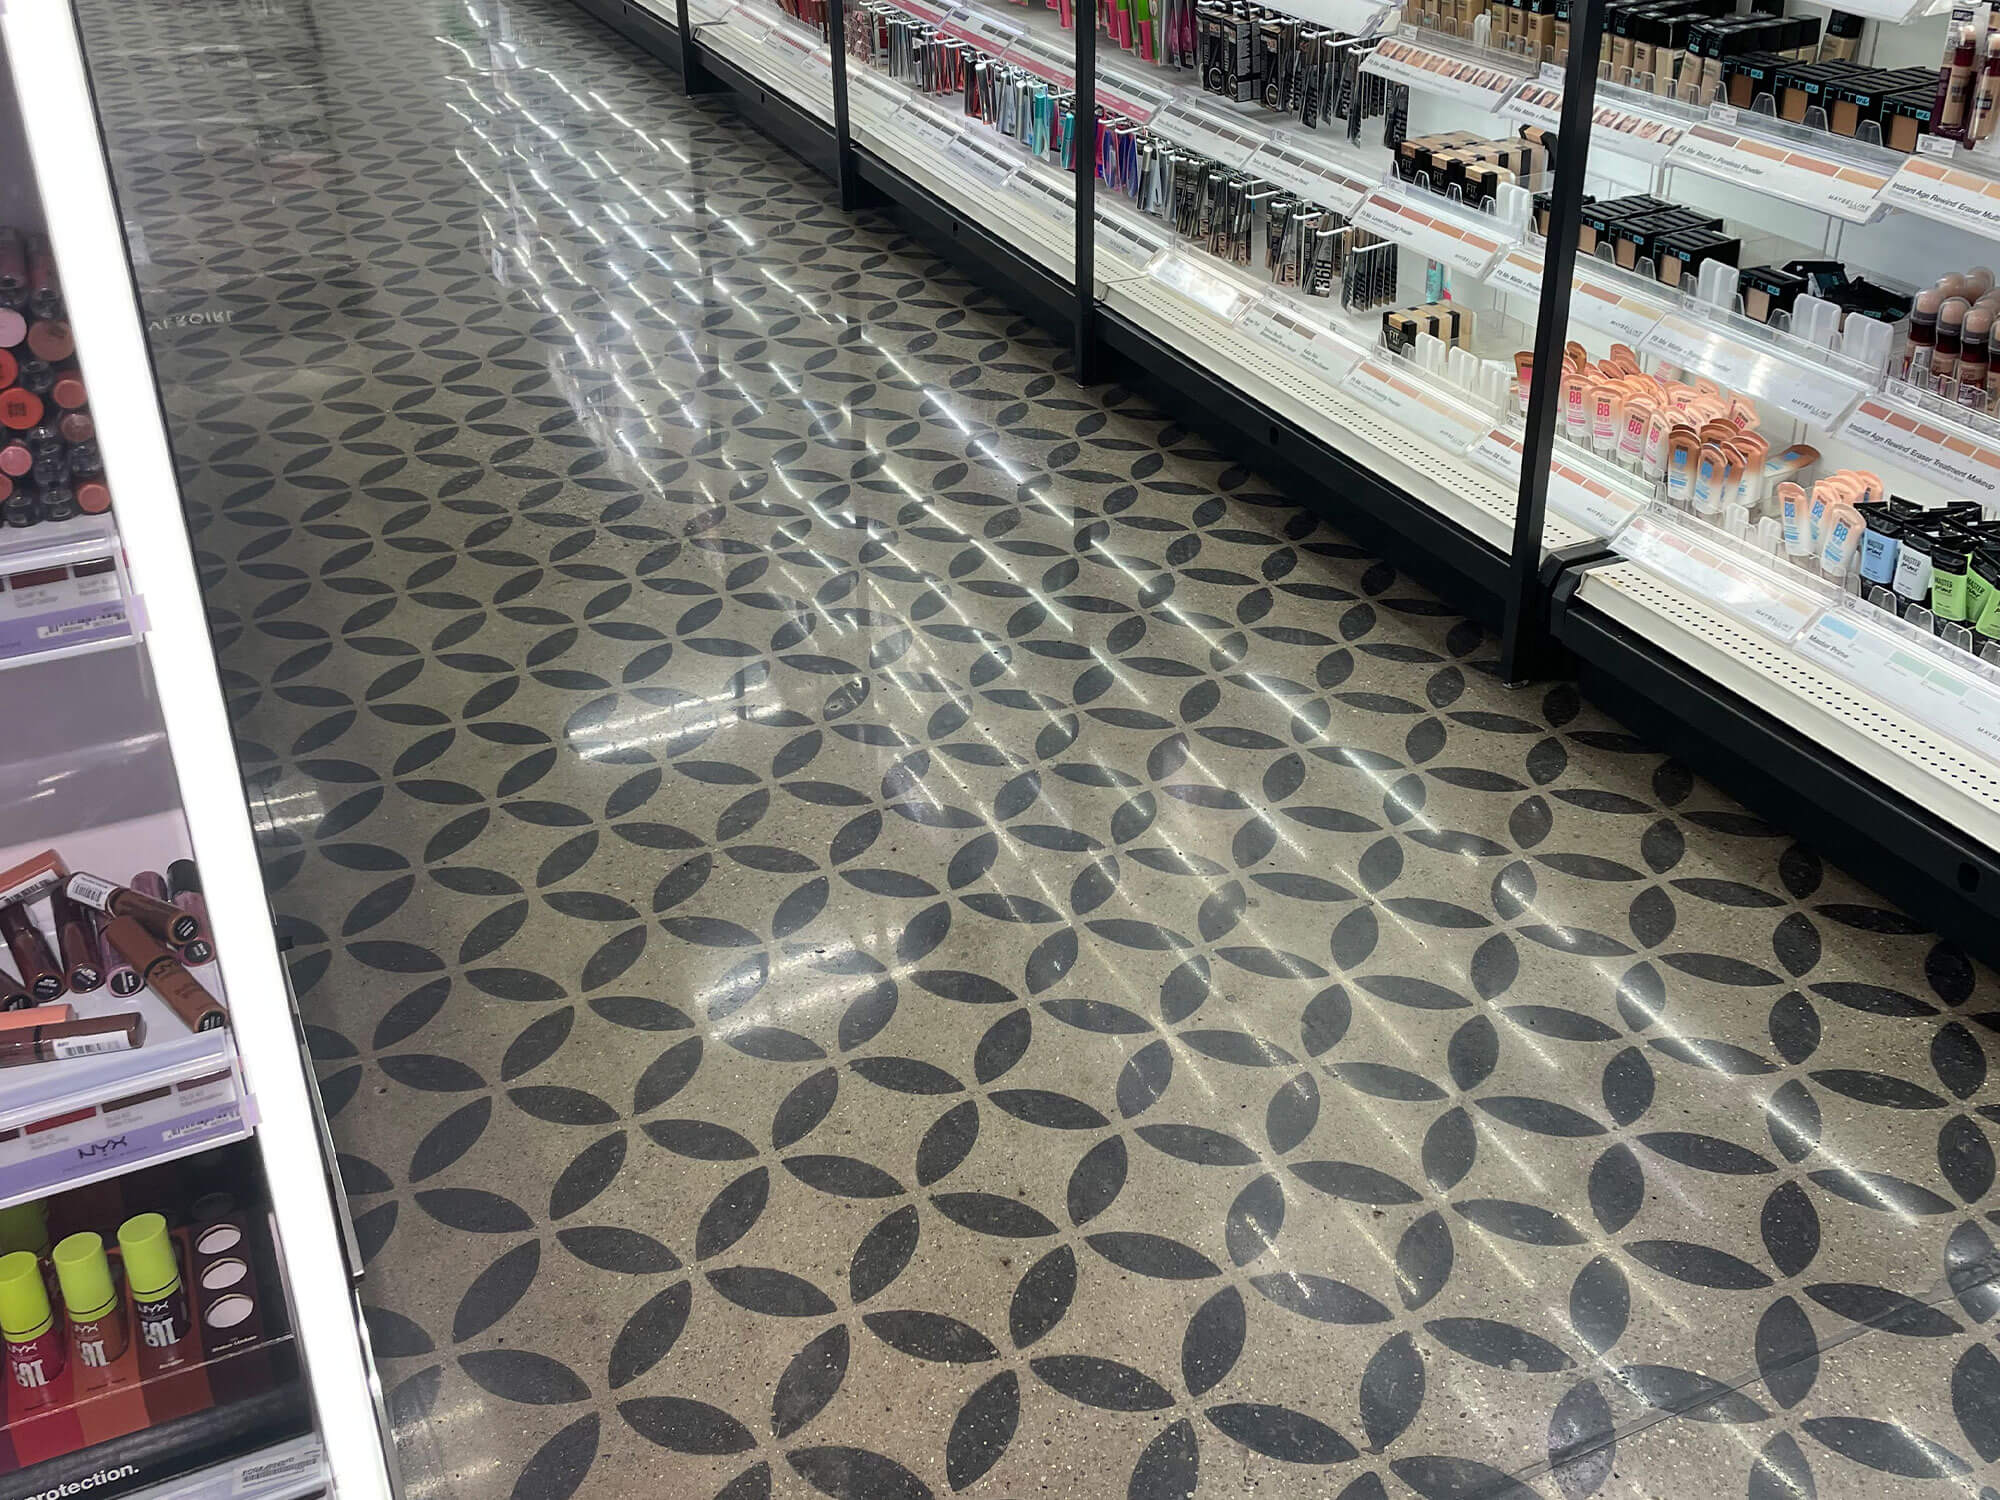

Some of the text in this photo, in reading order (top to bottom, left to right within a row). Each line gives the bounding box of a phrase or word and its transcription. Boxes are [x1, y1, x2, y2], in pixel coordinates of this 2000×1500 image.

[1721, 61, 1751, 81] FIT
[1773, 74, 1805, 95] FIT
[1822, 86, 1856, 107] FIT
[1880, 101, 1916, 121] FIT
[1892, 182, 1916, 195] Instant
[1930, 194, 1958, 209] Rewind
[1958, 202, 1982, 216] Eraser
[1653, 242, 1679, 260] FIT
[1315, 260, 1332, 290] 36H
[1389, 330, 1400, 341] FIT
[1569, 391, 1582, 405] BB
[1597, 402, 1610, 417] BB
[1792, 398, 1833, 419] MAYBELLINE
[1628, 419, 1643, 436] BB
[1650, 427, 1660, 443] BB
[1848, 422, 1996, 491] Instant Age Rewind Eraser Treatment Makeup
[1833, 522, 1849, 541] BB
[1808, 634, 1850, 659] Master Prime
[78, 1135, 128, 1159] NYX
[24, 1464, 140, 1500] rotection.
